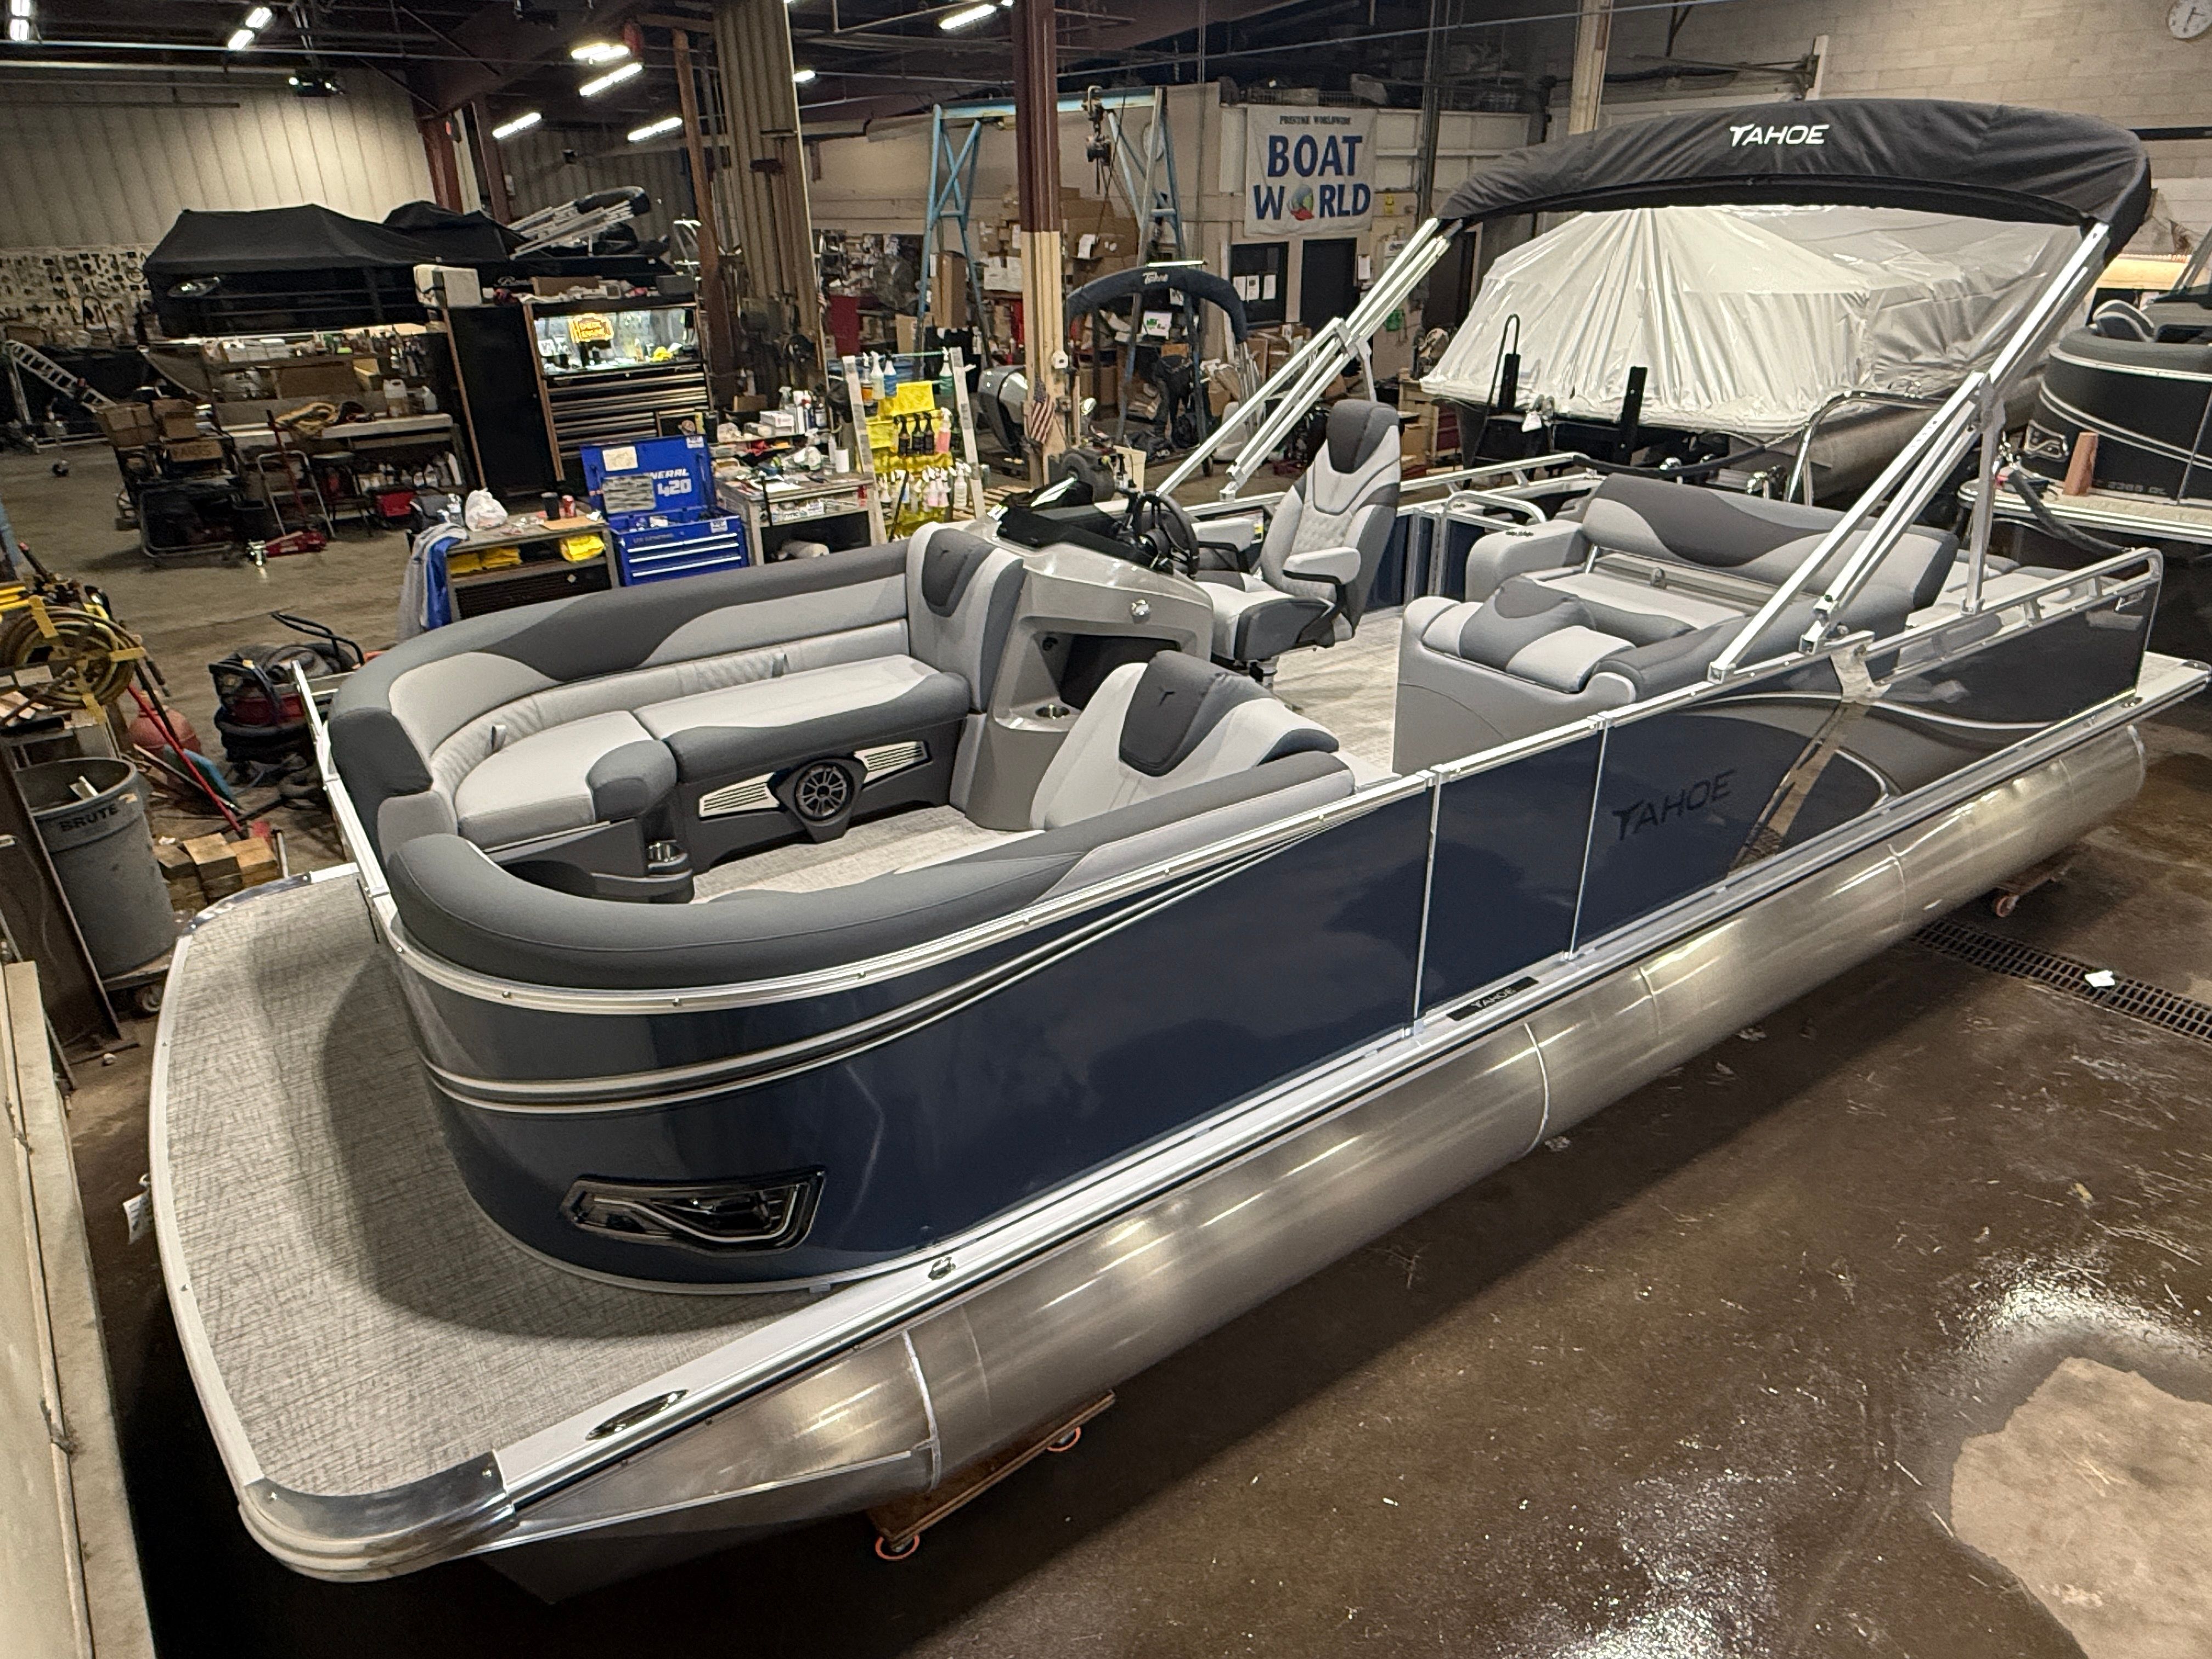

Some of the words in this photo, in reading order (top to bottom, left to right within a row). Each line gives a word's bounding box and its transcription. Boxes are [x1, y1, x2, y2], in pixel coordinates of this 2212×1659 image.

[1729, 123, 1830, 147] TAHOE
[1267, 134, 1363, 178] BOAT
[644, 468, 690, 480] NERAL
[657, 478, 692, 497] 420
[1613, 769, 1736, 840] TAHOE
[59, 803, 120, 832] BRUTE
[1471, 986, 1516, 1009] TAHOE
